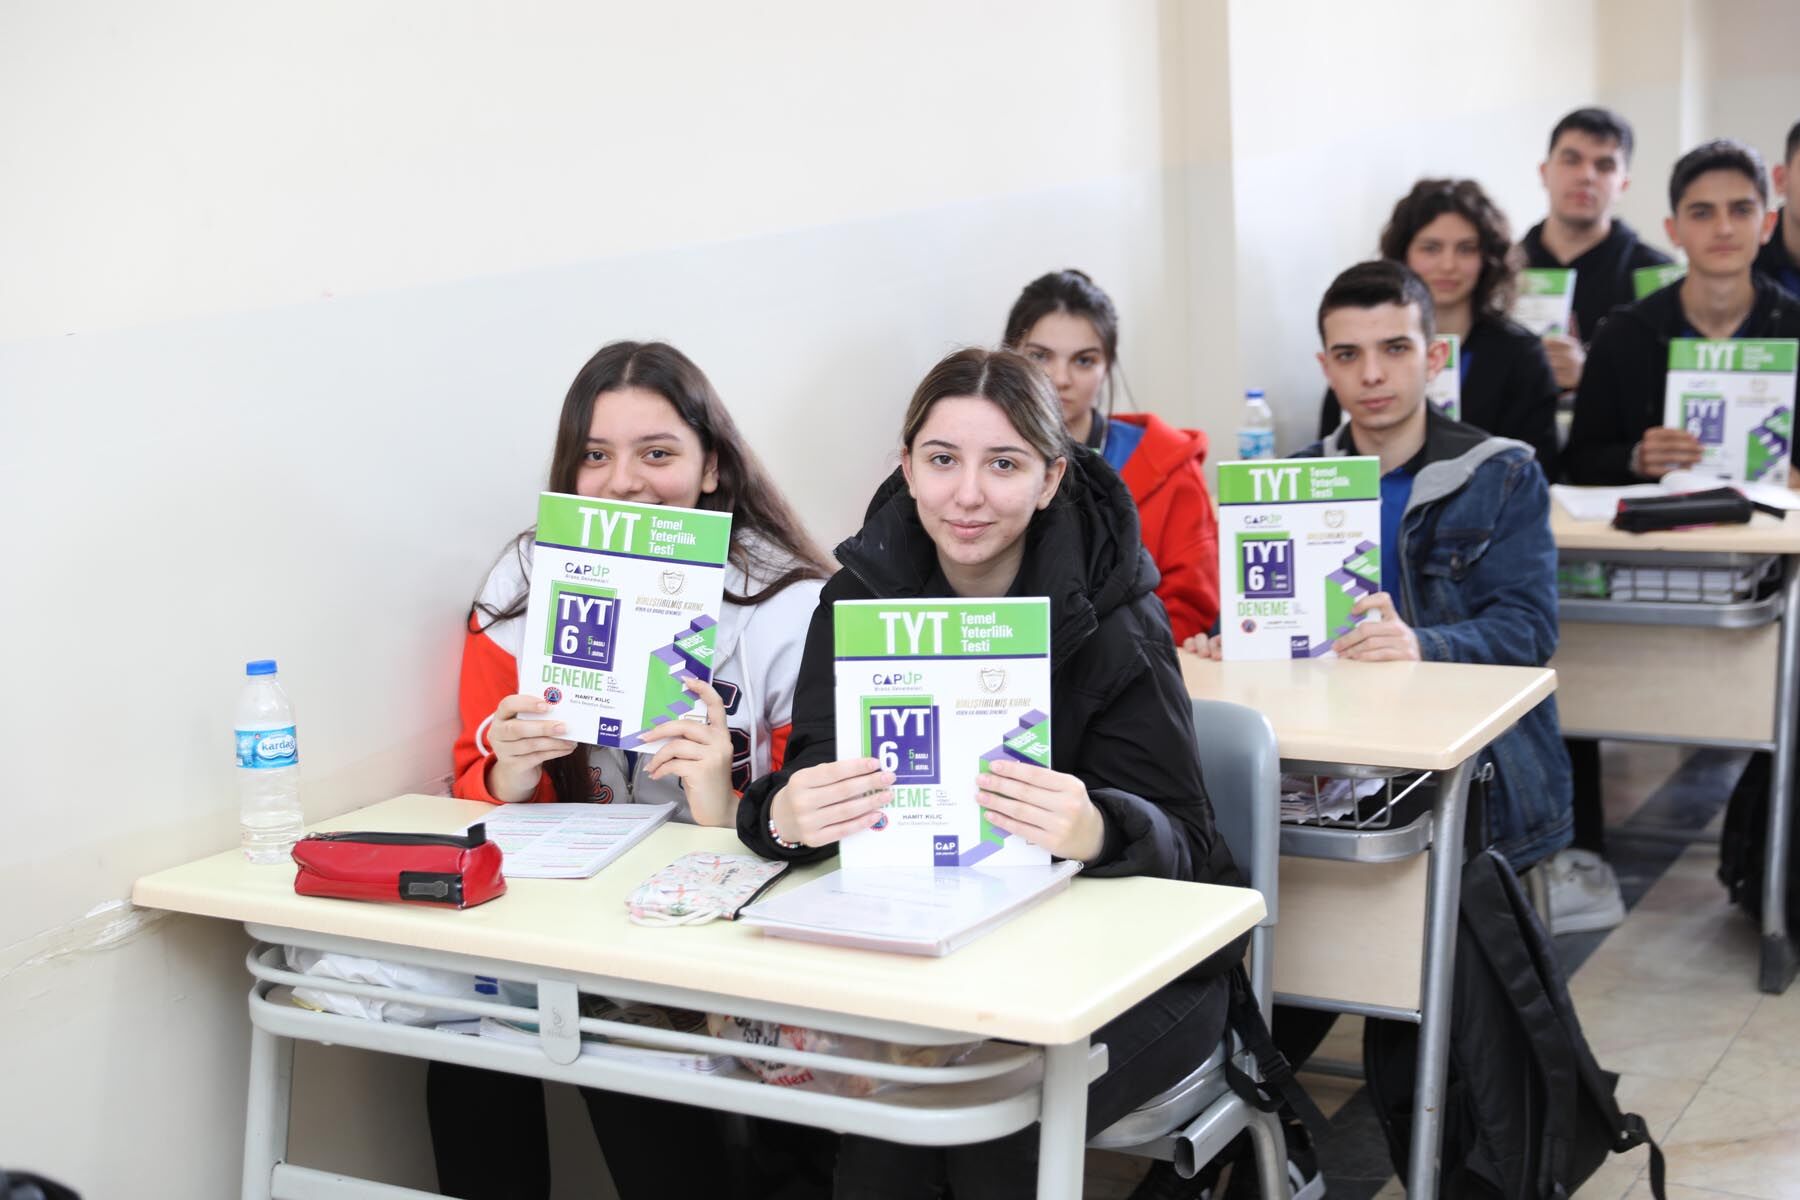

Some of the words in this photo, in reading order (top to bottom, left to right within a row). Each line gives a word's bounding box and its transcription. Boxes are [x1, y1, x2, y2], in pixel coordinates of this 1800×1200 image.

[1696, 342, 1737, 370] TYT
[1248, 467, 1302, 501] TYT
[578, 506, 642, 552] TYT
[651, 516, 683, 530] Temel
[648, 541, 674, 556] Testi
[650, 529, 696, 545] Yeterlilik
[1243, 541, 1288, 563] TYT
[1248, 565, 1265, 591] 6
[560, 593, 612, 626] TYT
[961, 611, 996, 625] Temel
[1237, 601, 1289, 617] DENEME
[560, 625, 579, 655] 6
[878, 611, 949, 655] TYT
[961, 625, 1014, 639] Yeterlilik
[961, 639, 990, 652] Testi
[542, 664, 604, 691] DENEME
[870, 708, 931, 737] TYT
[879, 741, 899, 772] 6
[879, 787, 932, 808] NEME
[935, 842, 956, 850] CAP
